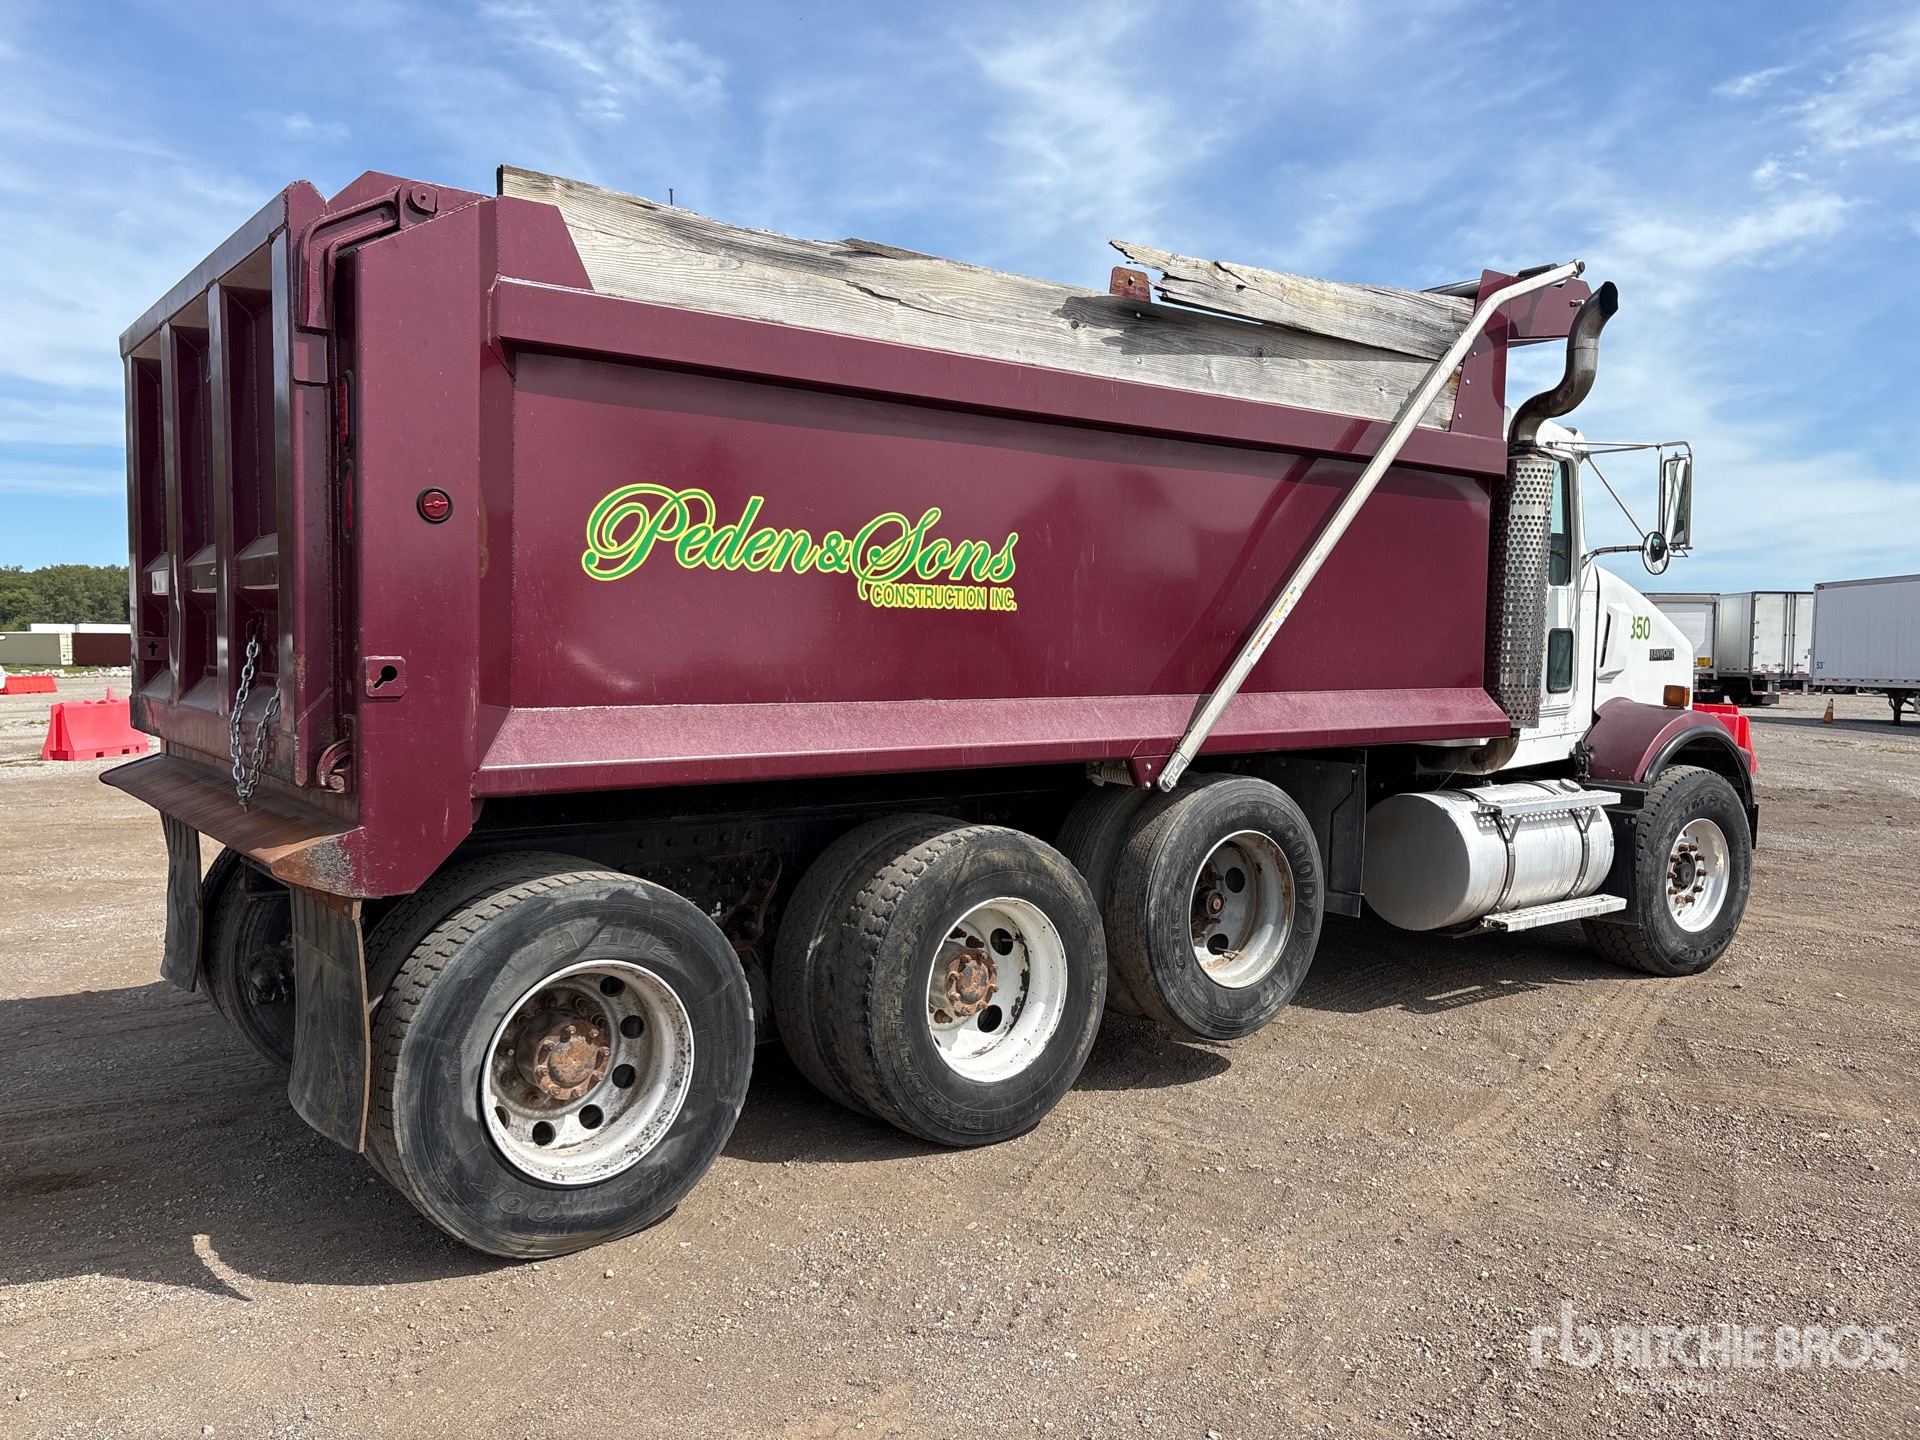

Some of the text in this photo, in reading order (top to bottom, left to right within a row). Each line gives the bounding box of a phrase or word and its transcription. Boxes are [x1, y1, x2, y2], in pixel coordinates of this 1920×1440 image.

[581, 482, 819, 582] Peden
[849, 506, 1019, 601] Sons
[869, 582, 1018, 612] CONSTRUCTION INC.
